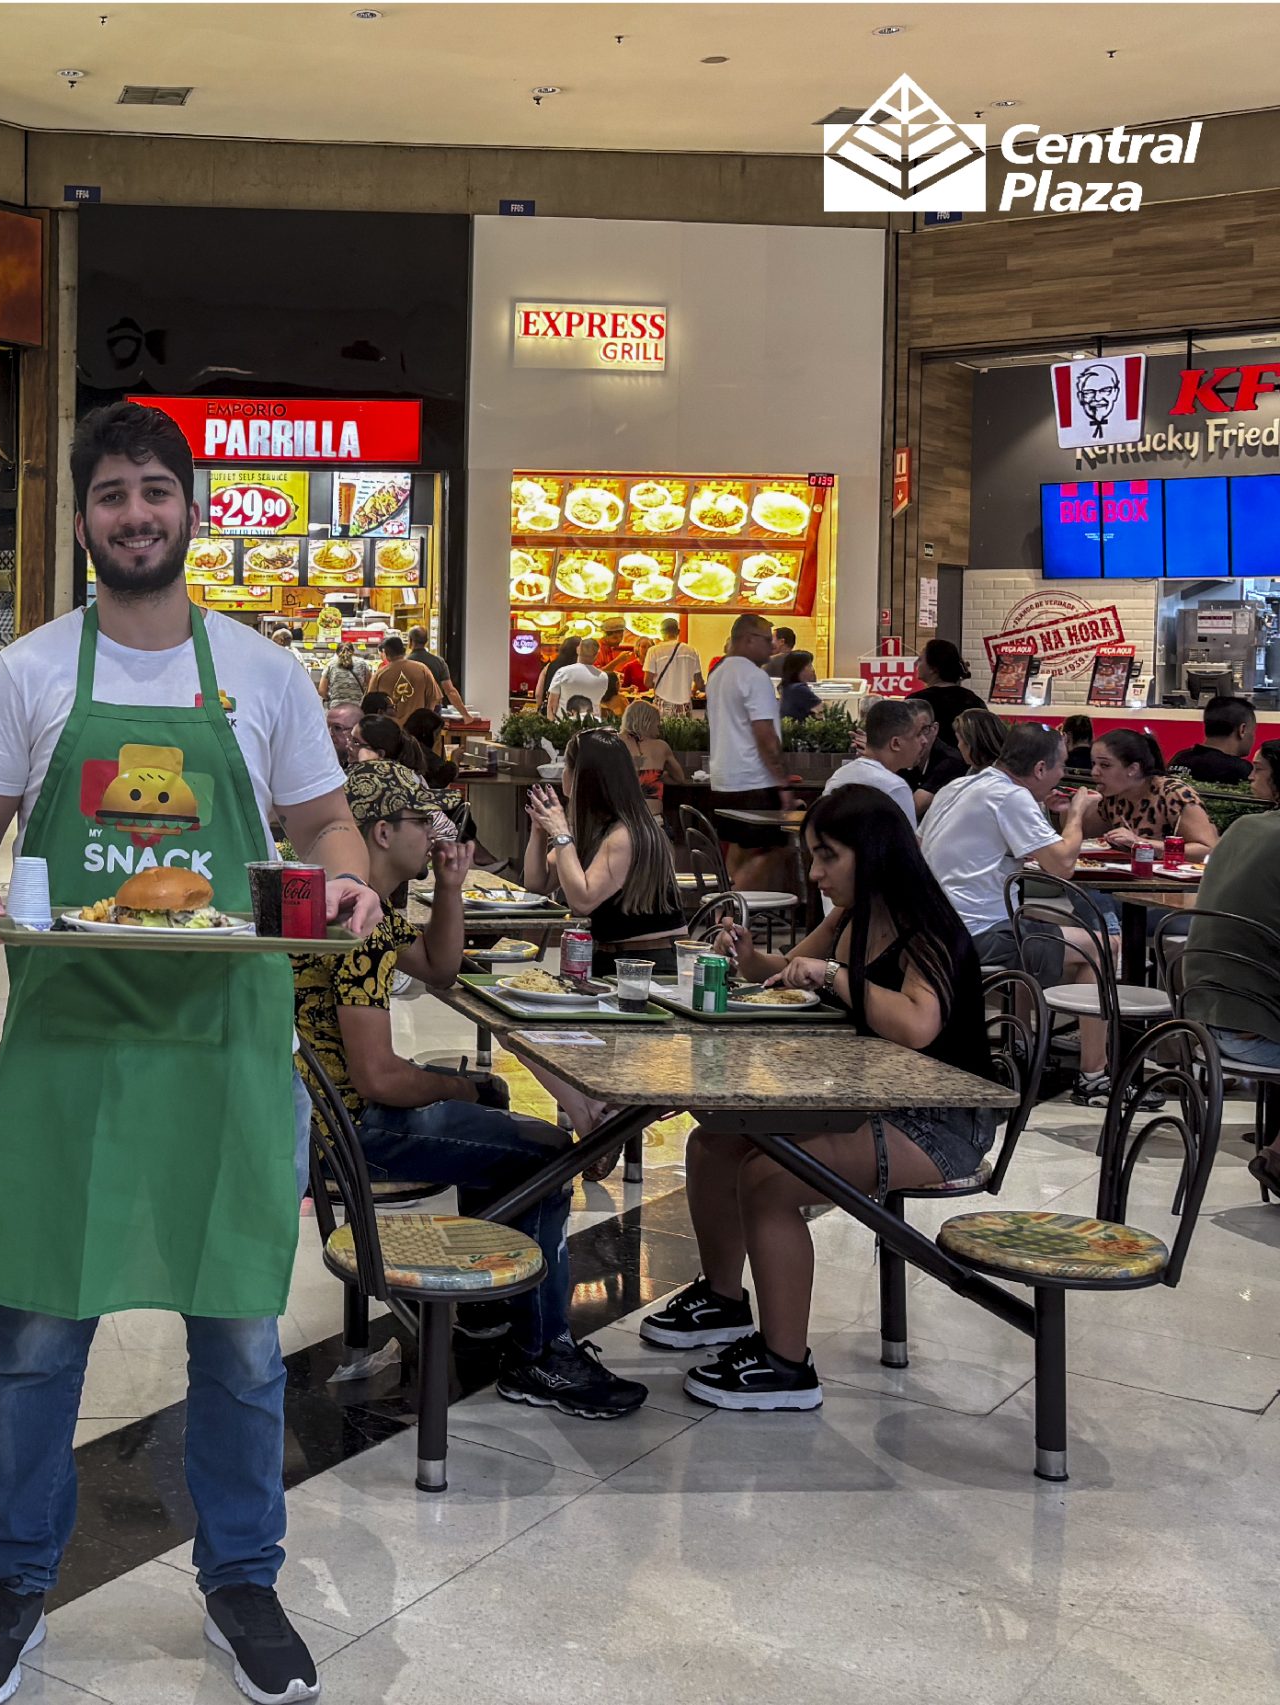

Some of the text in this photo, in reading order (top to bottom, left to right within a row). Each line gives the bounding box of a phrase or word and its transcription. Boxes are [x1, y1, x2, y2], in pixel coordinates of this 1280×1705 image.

[76, 190, 90, 199] FF04
[510, 204, 524, 213] FF05
[521, 310, 665, 340] EXPRESS
[602, 342, 664, 361] GRILL
[1169, 363, 1280, 416] KF
[204, 418, 362, 458] PARRILLA
[1206, 418, 1279, 452] Fried
[238, 473, 288, 481] SELF SERVICE
[222, 489, 287, 526] 29,90
[1060, 498, 1148, 524] BIG BOX
[1014, 604, 1034, 625] FRANGO
[1040, 628, 1063, 653] NA
[1065, 617, 1115, 645] HORA
[1100, 647, 1116, 655] PEÇA
[1064, 657, 1085, 673] 1939
[872, 676, 914, 693] KFC
[89, 828, 102, 838] MY
[83, 843, 213, 880] SNACK
[284, 878, 312, 900] Cola
